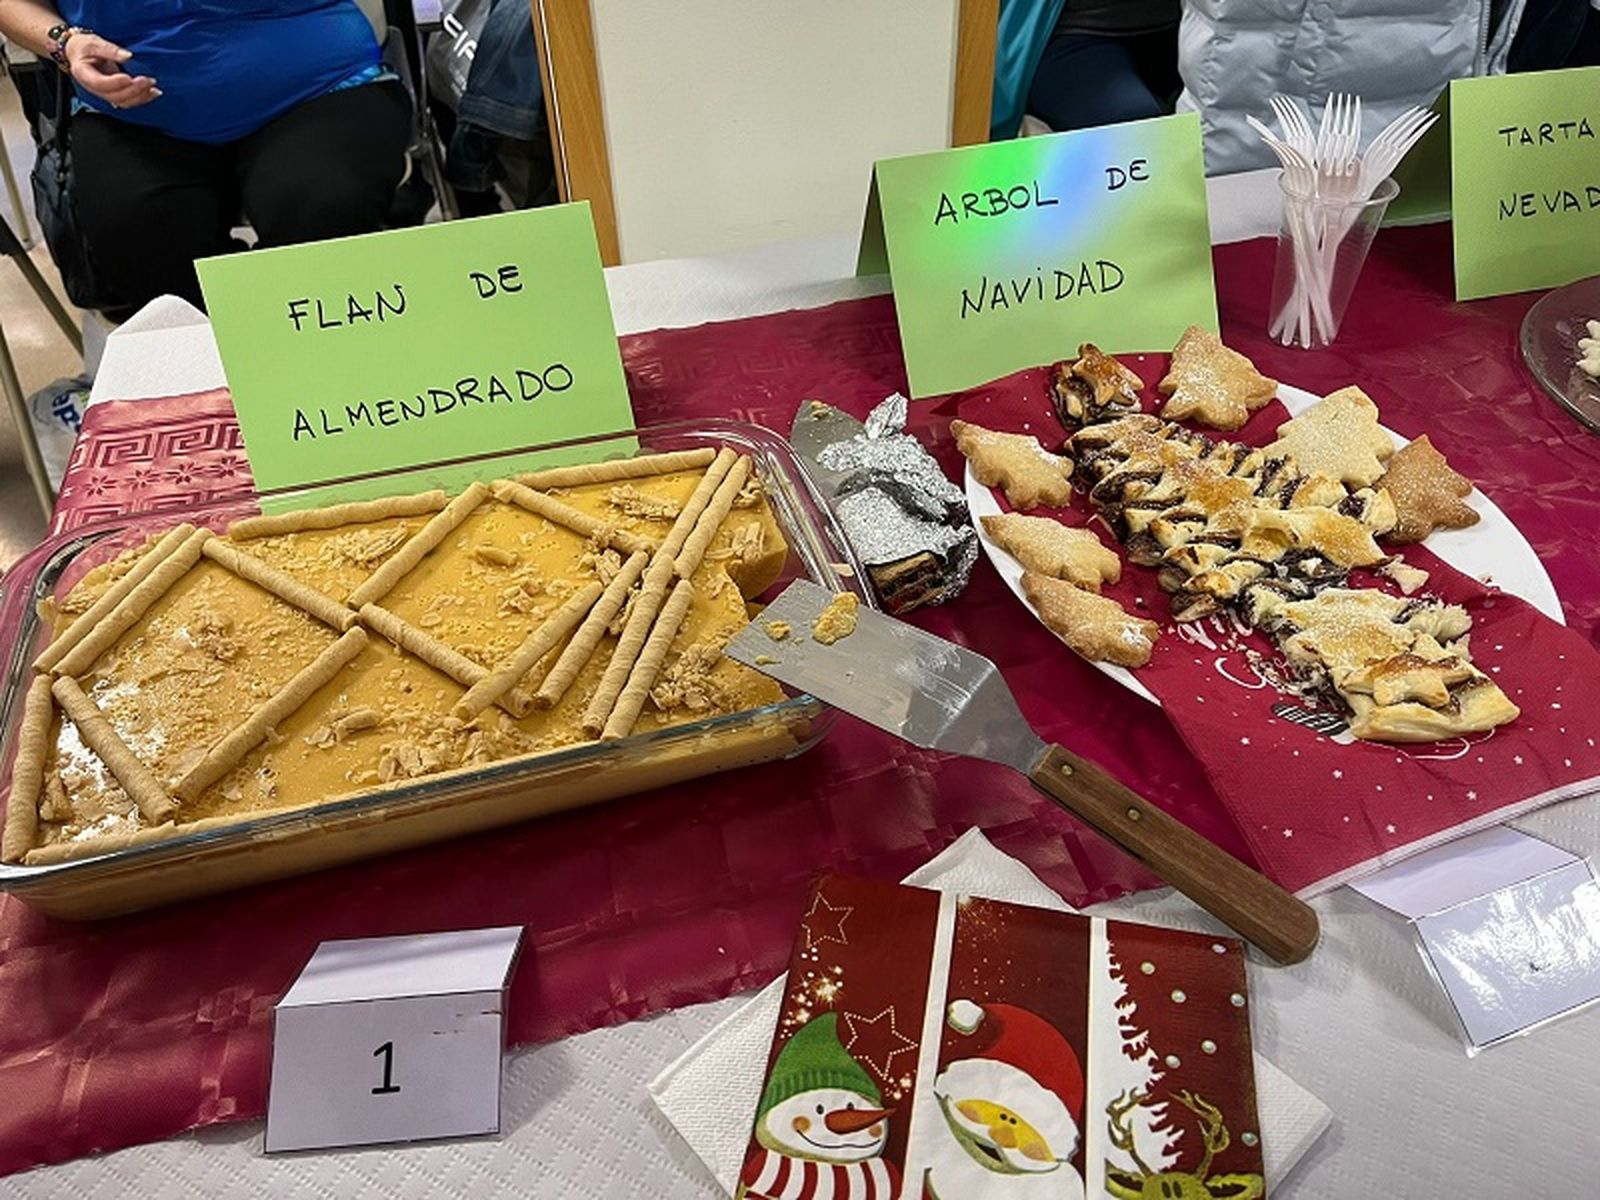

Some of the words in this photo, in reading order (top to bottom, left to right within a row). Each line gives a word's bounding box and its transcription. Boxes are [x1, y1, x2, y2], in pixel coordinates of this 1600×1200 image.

[1498, 118, 1595, 146] TARTA
[934, 180, 1059, 226] ARBOL
[1105, 159, 1150, 191] DE
[288, 284, 406, 331] FLAN
[469, 265, 523, 298] DE
[293, 363, 574, 441] ALMENDRADO
[371, 1041, 401, 1095] 1
